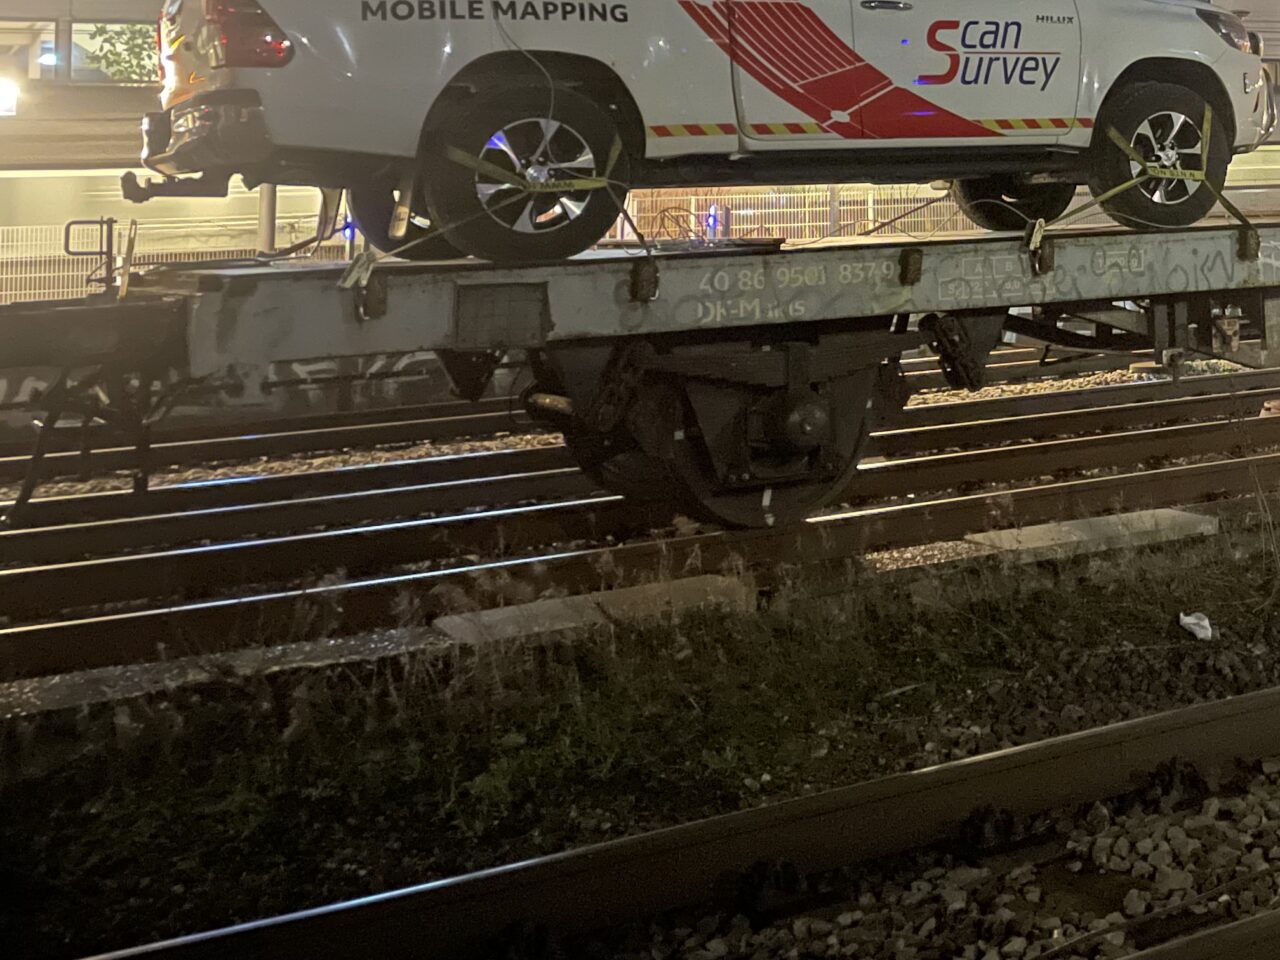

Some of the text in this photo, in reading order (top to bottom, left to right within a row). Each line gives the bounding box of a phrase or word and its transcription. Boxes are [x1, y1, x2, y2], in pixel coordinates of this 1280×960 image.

[361, 0, 629, 23] MOBILE MAPPING
[1035, 14, 1074, 24] HILUX
[926, 20, 1022, 52] Scan
[918, 51, 1061, 91] Survey
[738, 269, 766, 290] 86
